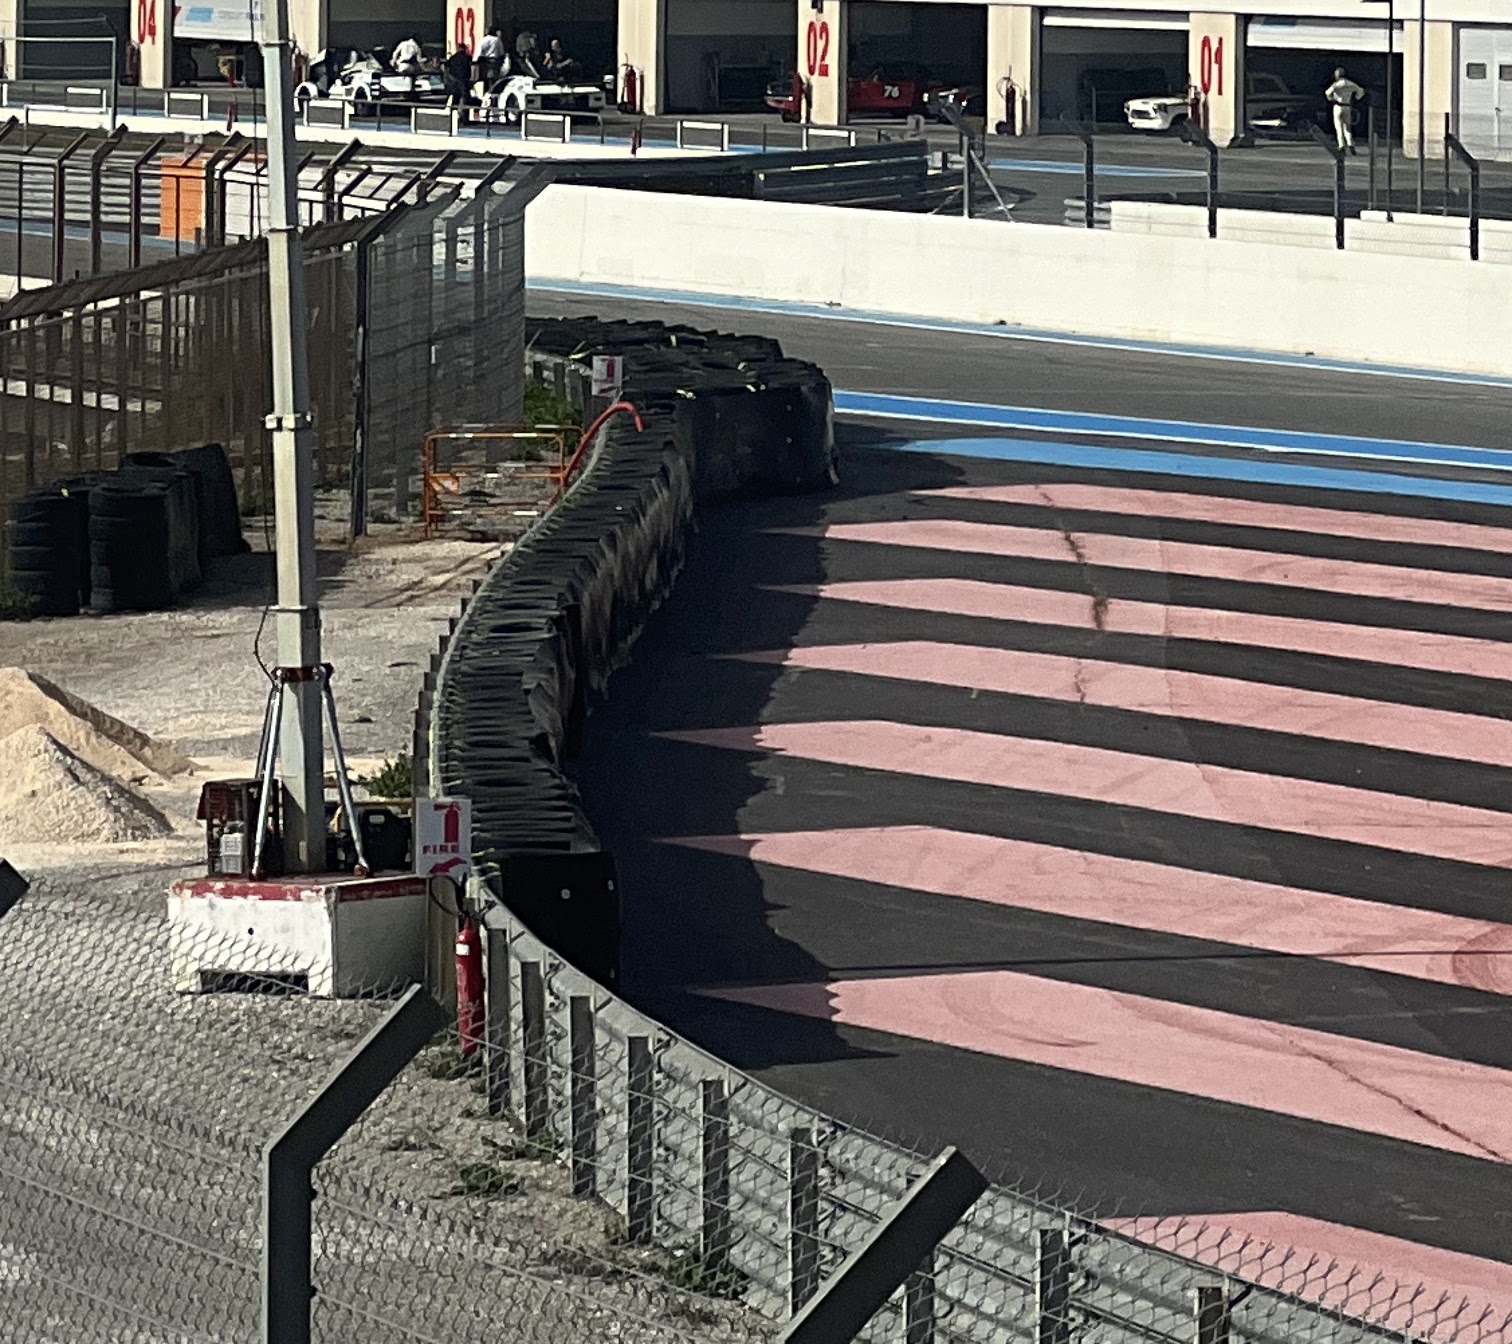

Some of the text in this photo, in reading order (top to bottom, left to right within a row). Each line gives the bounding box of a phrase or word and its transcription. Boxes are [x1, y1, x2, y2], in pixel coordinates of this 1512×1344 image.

[455, 7, 475, 57] 03
[806, 21, 829, 77] 02
[1200, 35, 1223, 96] 01
[422, 844, 460, 855] FIRE
